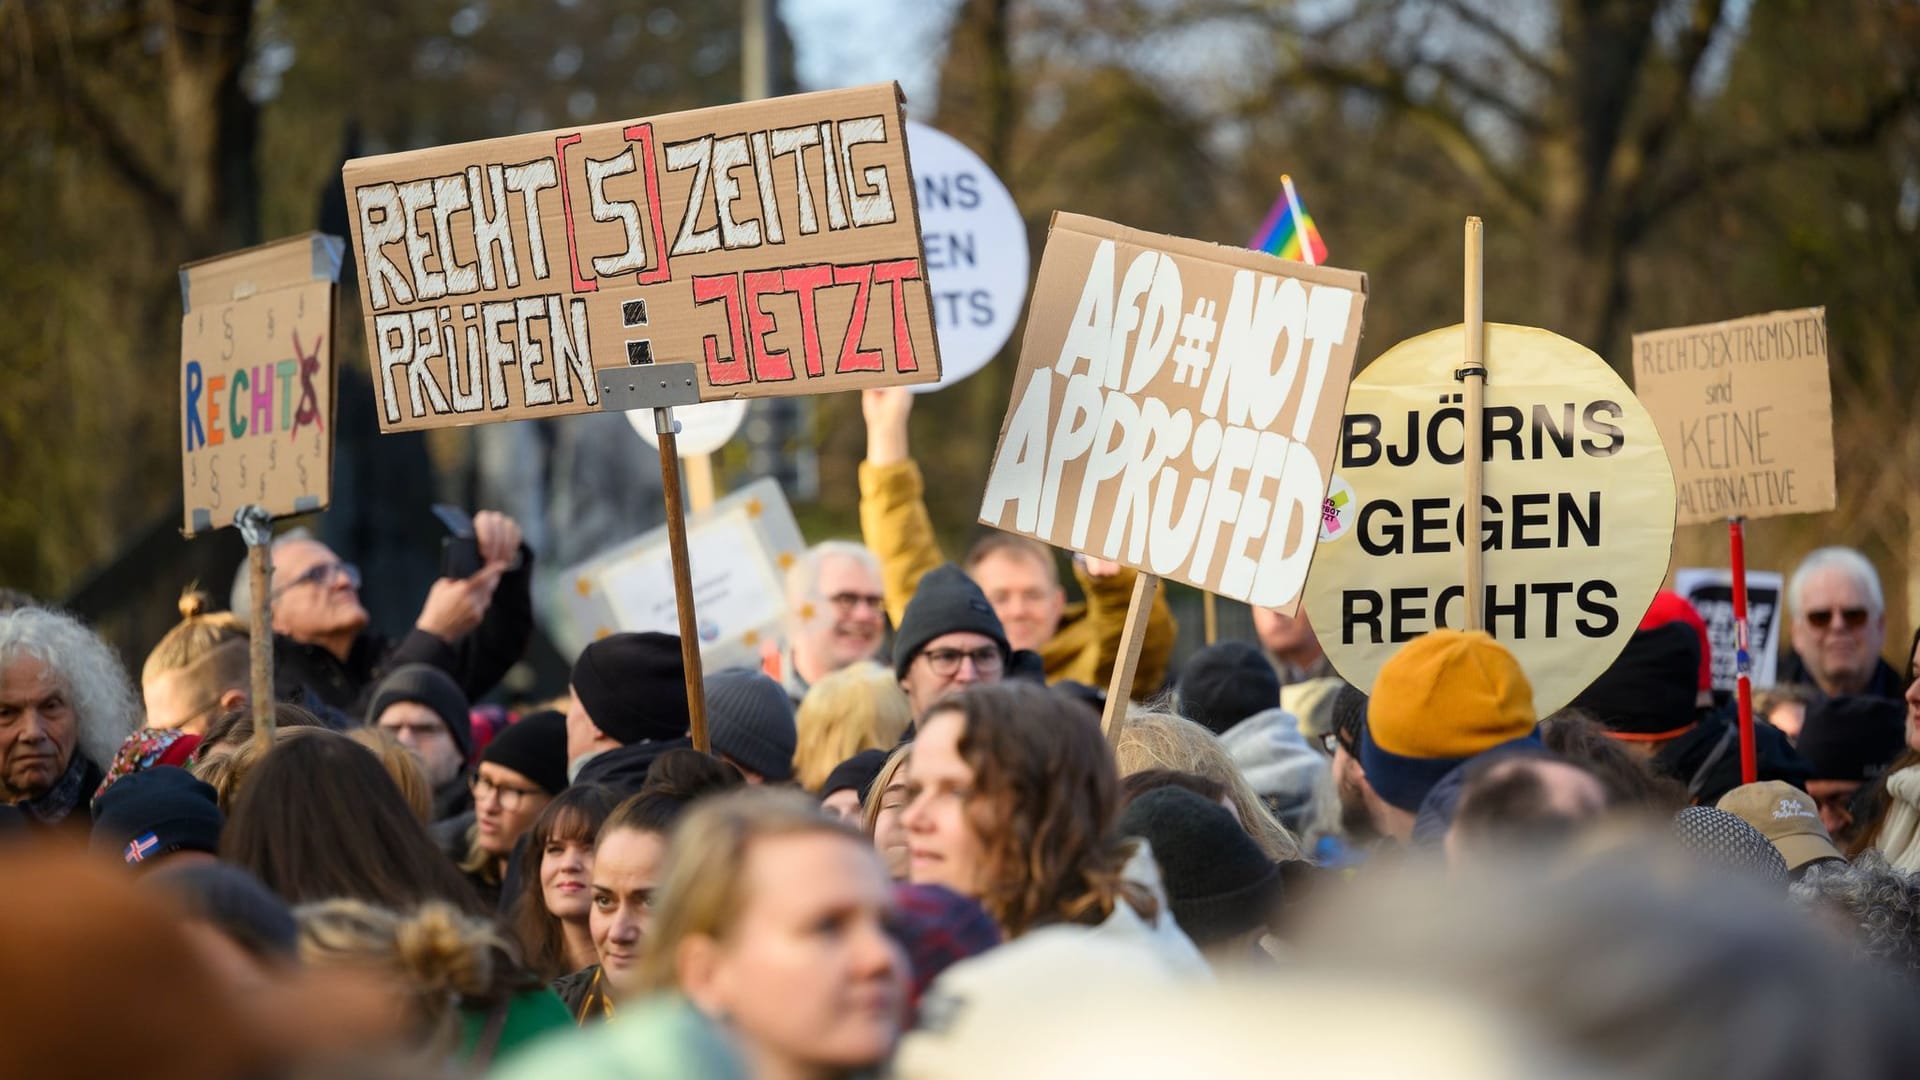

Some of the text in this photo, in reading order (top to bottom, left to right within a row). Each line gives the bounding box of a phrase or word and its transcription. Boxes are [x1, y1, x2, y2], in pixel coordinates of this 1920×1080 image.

[374, 293, 600, 424] PRÜFEN
[692, 258, 921, 388] JETZT
[1641, 316, 1827, 375] RECHTSEXTREMISTEN
[1705, 372, 1733, 405] sind
[1341, 394, 1625, 468] BJÖRNS
[1680, 406, 1776, 470] KEINE
[978, 366, 1325, 608] APPRÜFED
[1679, 469, 1799, 514] ALTERNATIVE
[1356, 491, 1601, 556] GEGEN
